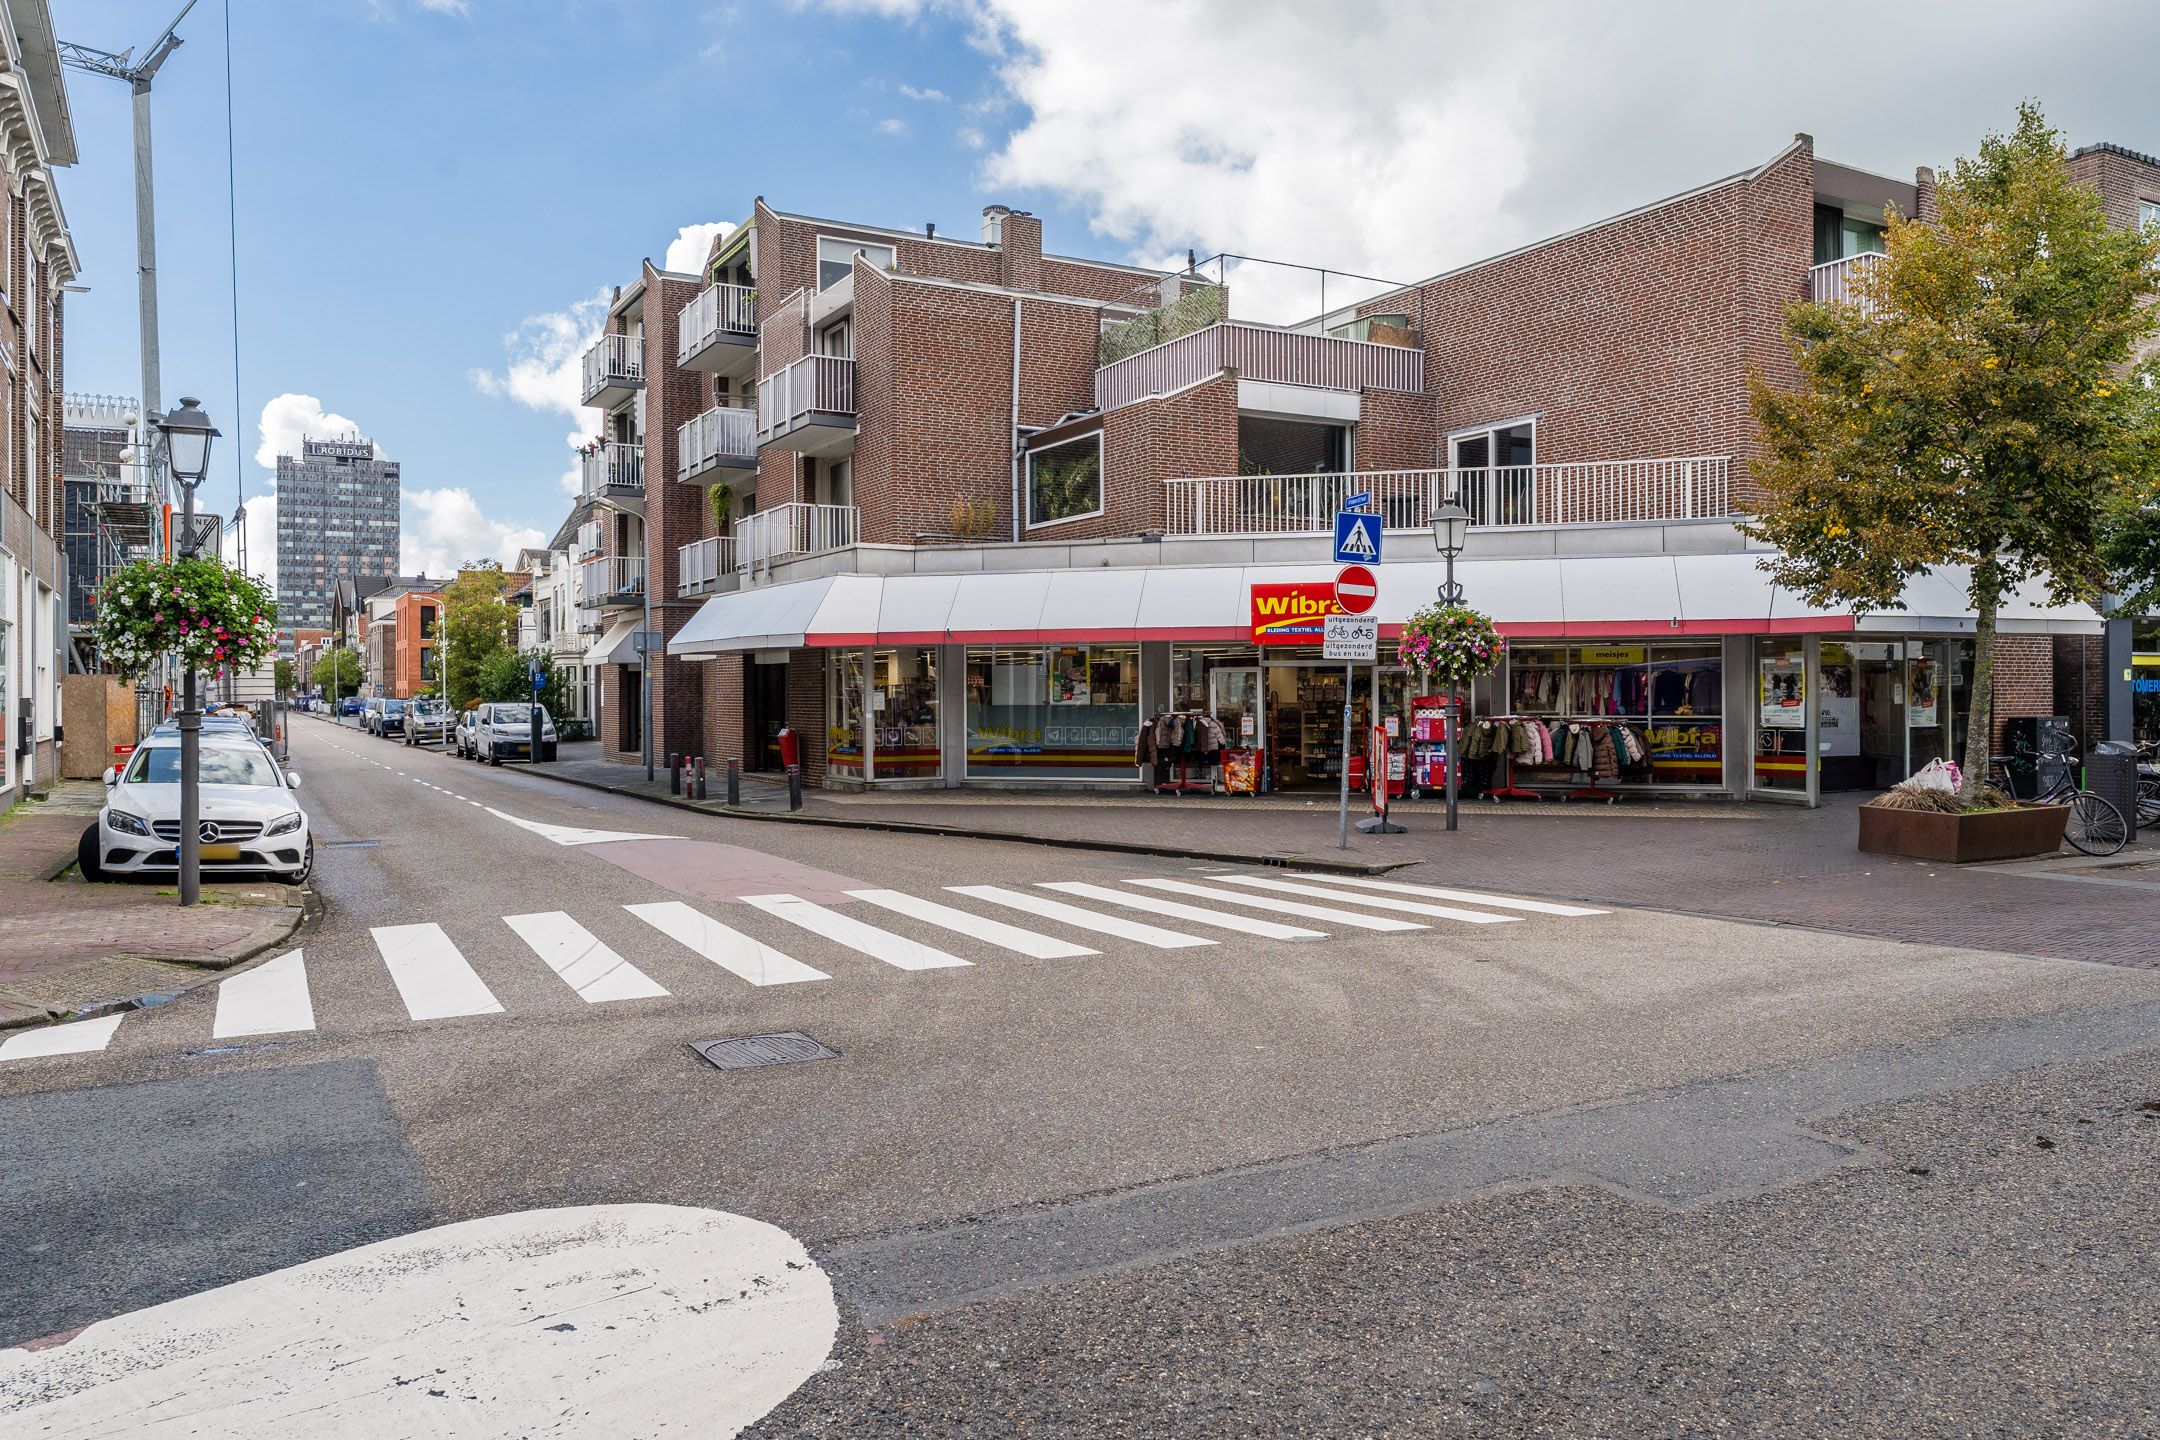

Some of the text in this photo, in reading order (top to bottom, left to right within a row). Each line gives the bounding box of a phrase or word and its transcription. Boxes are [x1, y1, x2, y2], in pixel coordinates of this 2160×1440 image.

[321, 447, 369, 457] ROBIDUS
[181, 517, 208, 526] ZNE
[1256, 590, 1346, 615] Wibra
[1328, 616, 1375, 624] uitgezonderd
[1595, 651, 1629, 660] meisjes
